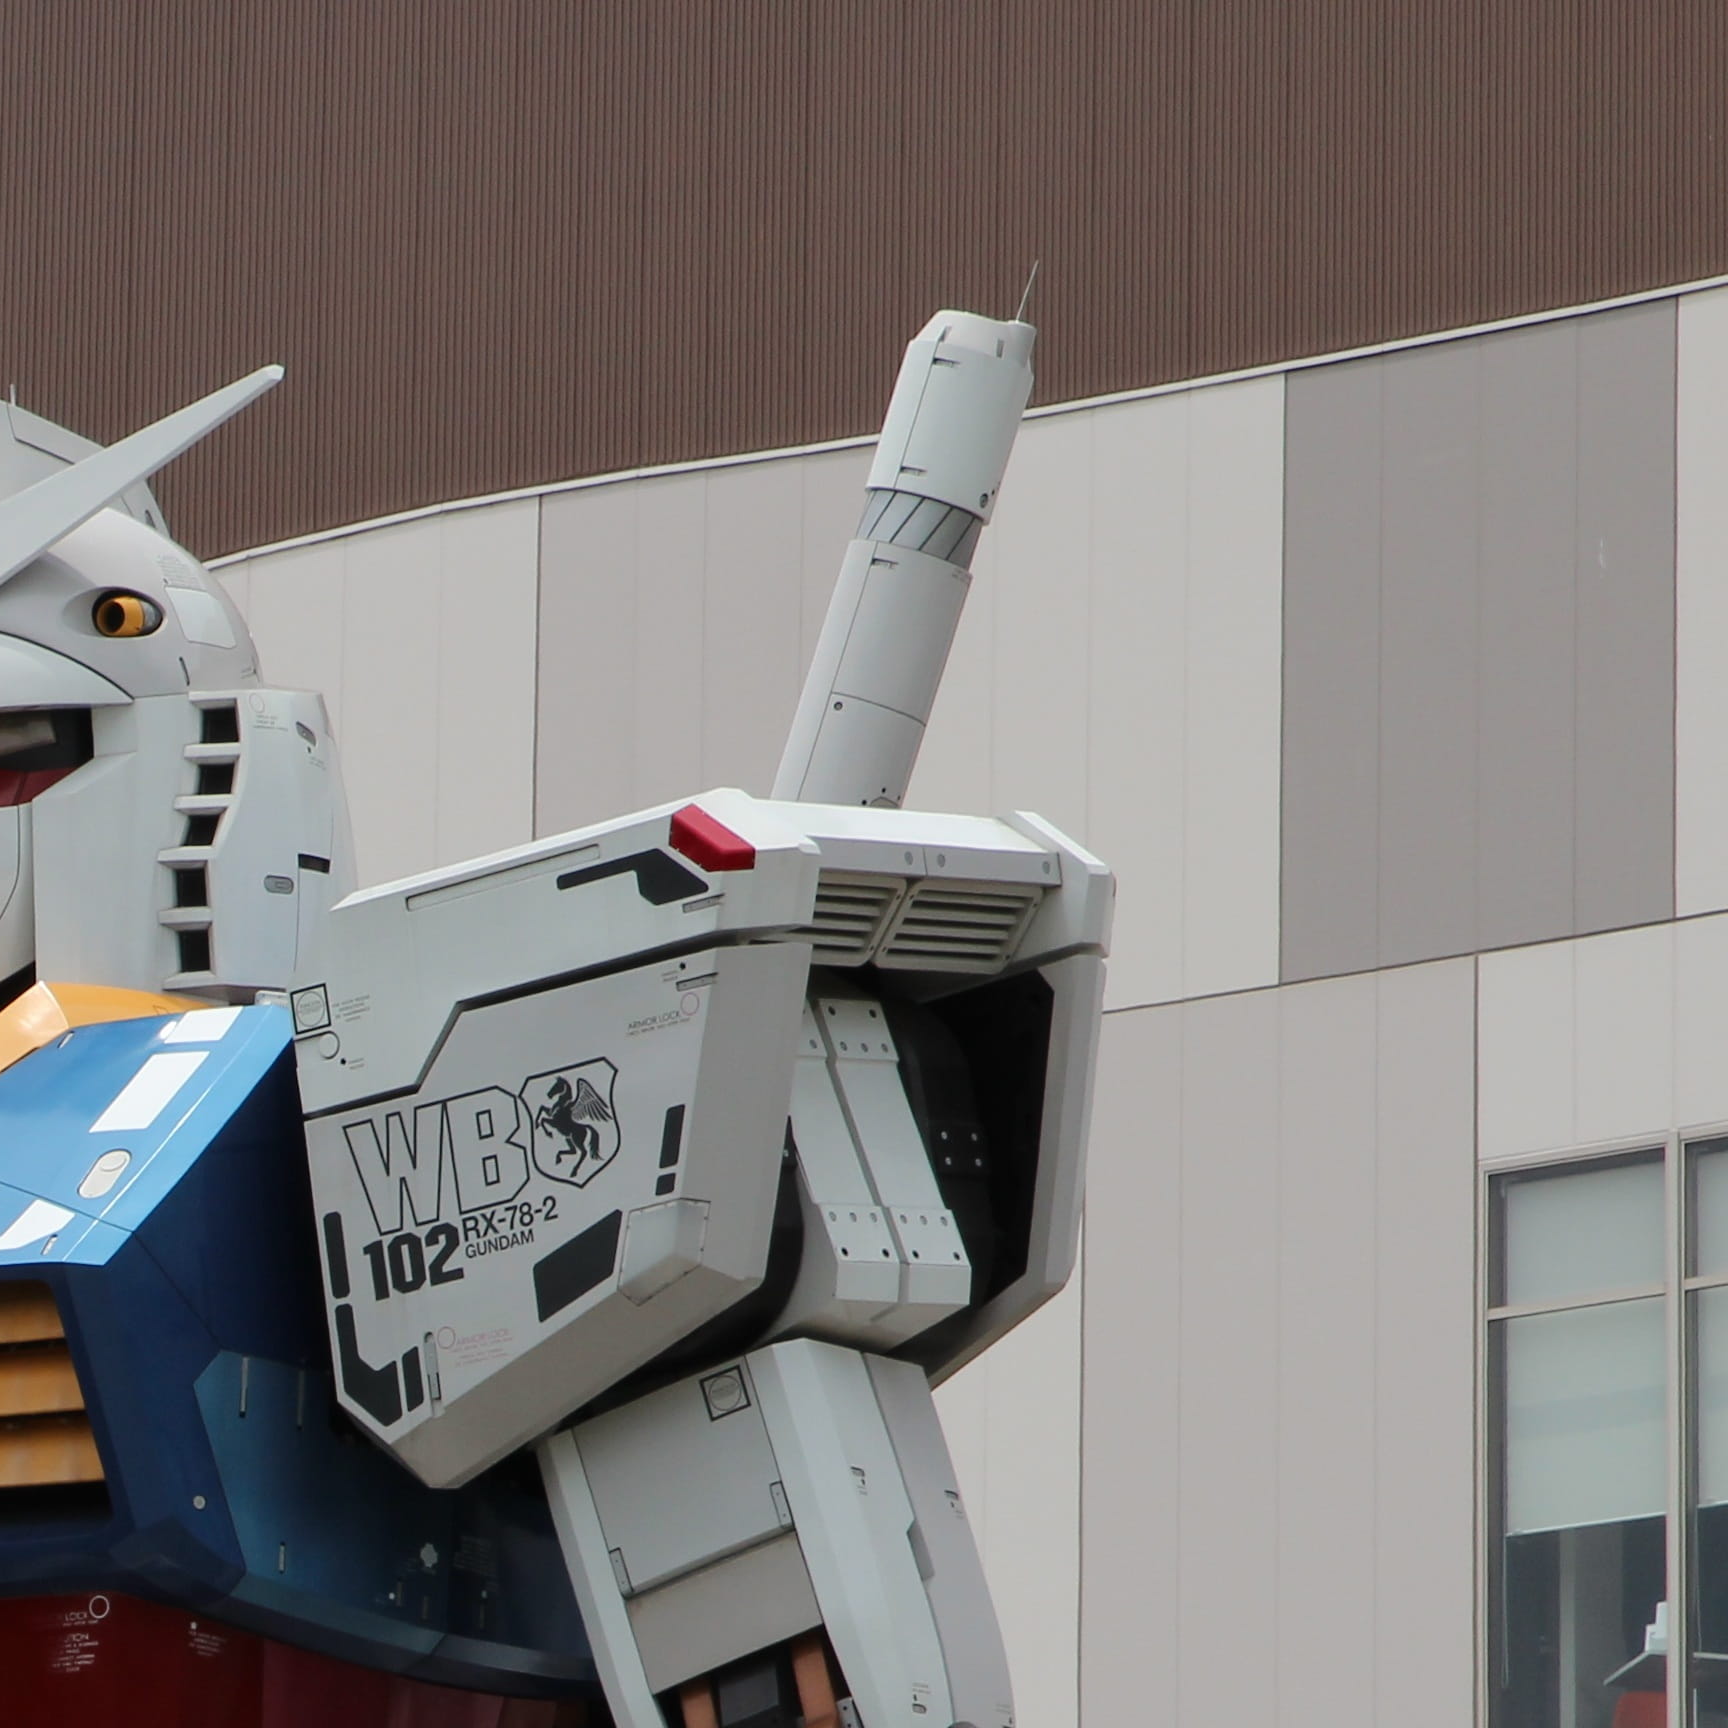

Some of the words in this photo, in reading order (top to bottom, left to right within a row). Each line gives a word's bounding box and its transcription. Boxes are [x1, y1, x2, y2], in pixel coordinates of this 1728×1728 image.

[342, 1086, 531, 1236] WB
[461, 1196, 558, 1241] RX-78-2
[464, 1229, 534, 1258] GUNDAM
[363, 1222, 464, 1301] 102
